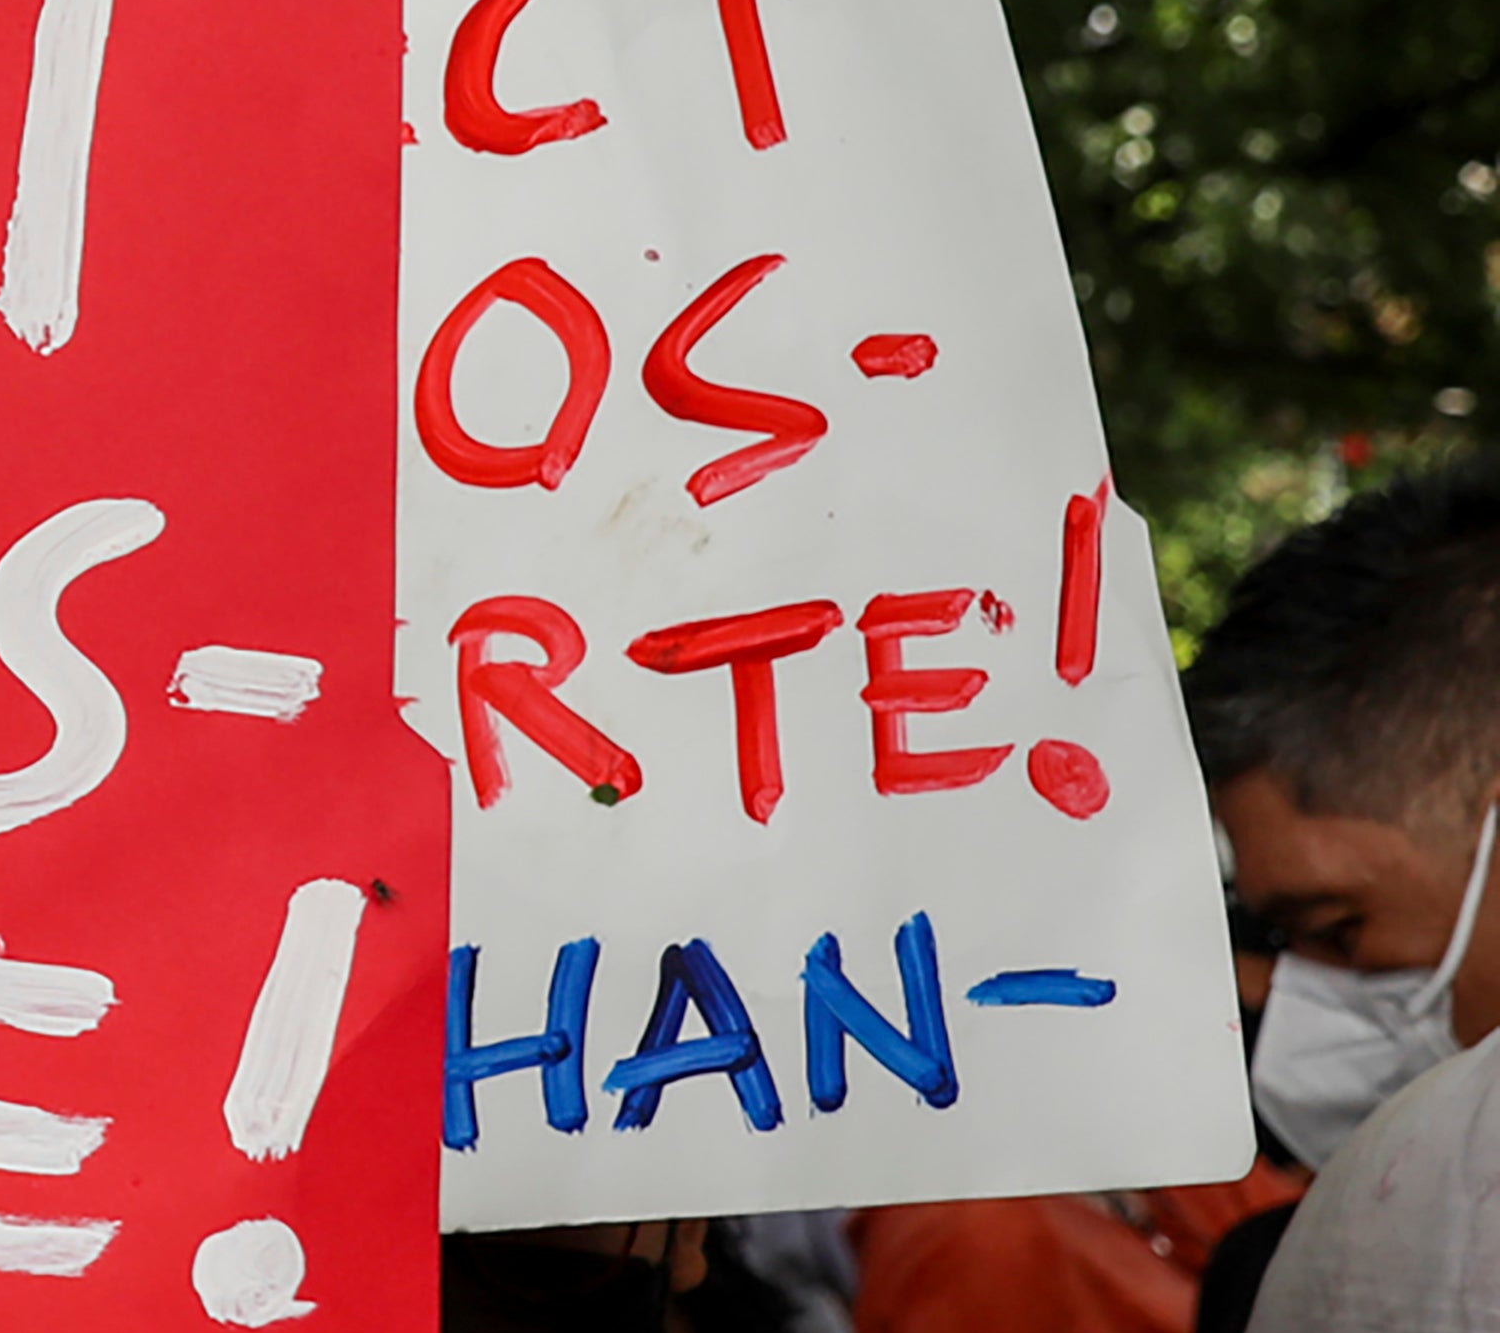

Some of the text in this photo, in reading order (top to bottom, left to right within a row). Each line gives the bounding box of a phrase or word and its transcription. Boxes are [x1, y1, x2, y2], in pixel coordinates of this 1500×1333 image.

[414, 252, 940, 509] OS-
[397, 472, 1112, 827] RTE!
[442, 909, 1116, 1152] HAN-
